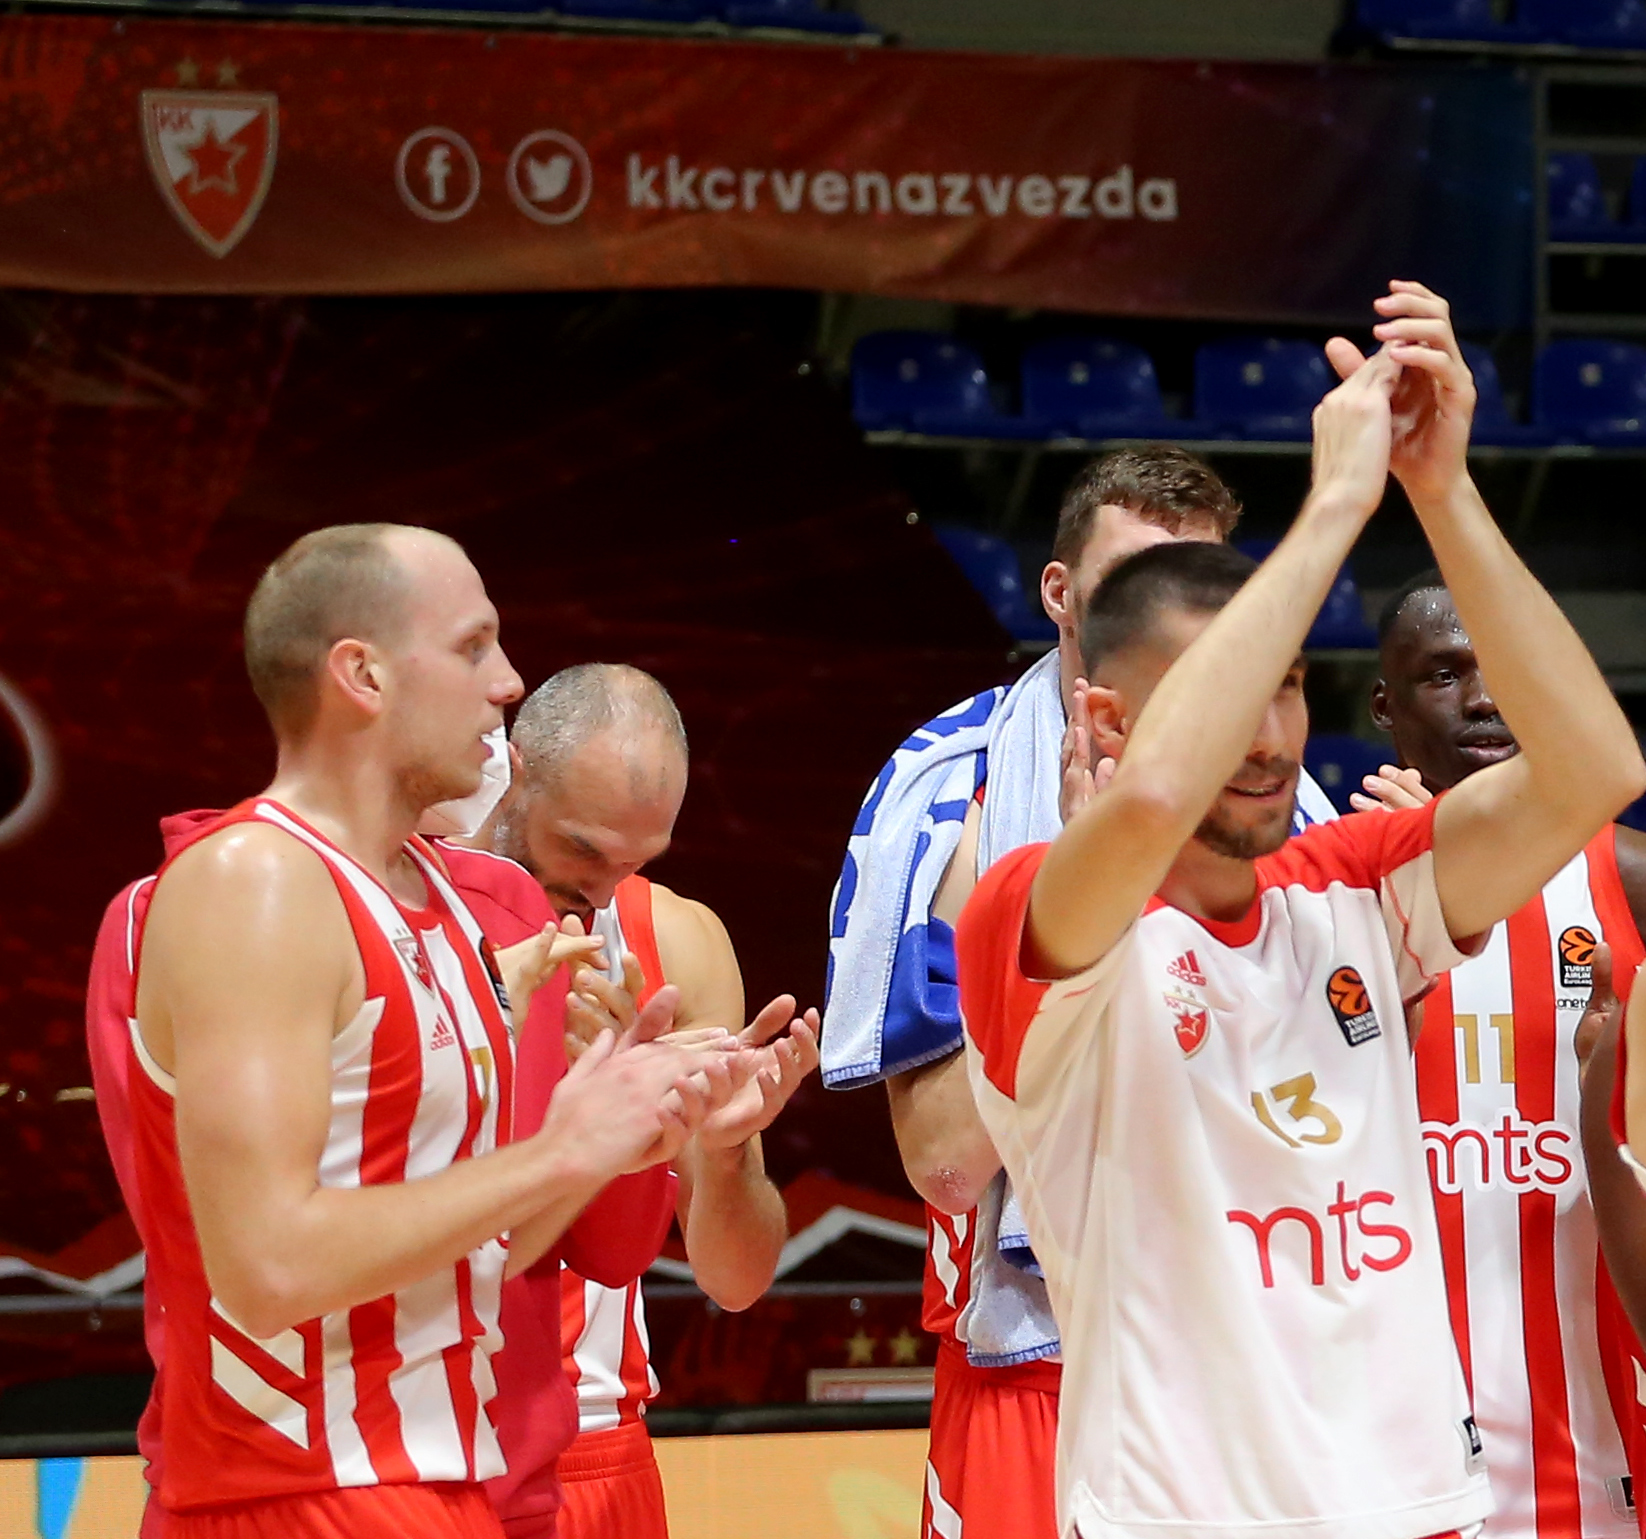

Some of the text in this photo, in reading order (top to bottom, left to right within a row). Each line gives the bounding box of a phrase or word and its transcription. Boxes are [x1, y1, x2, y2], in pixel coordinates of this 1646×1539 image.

[627, 153, 1178, 220] kkcrvenazvezda
[1453, 1013, 1514, 1084] 11
[1250, 1071, 1343, 1148] 13
[1422, 1114, 1573, 1187] mts
[1226, 1180, 1412, 1288] mts
